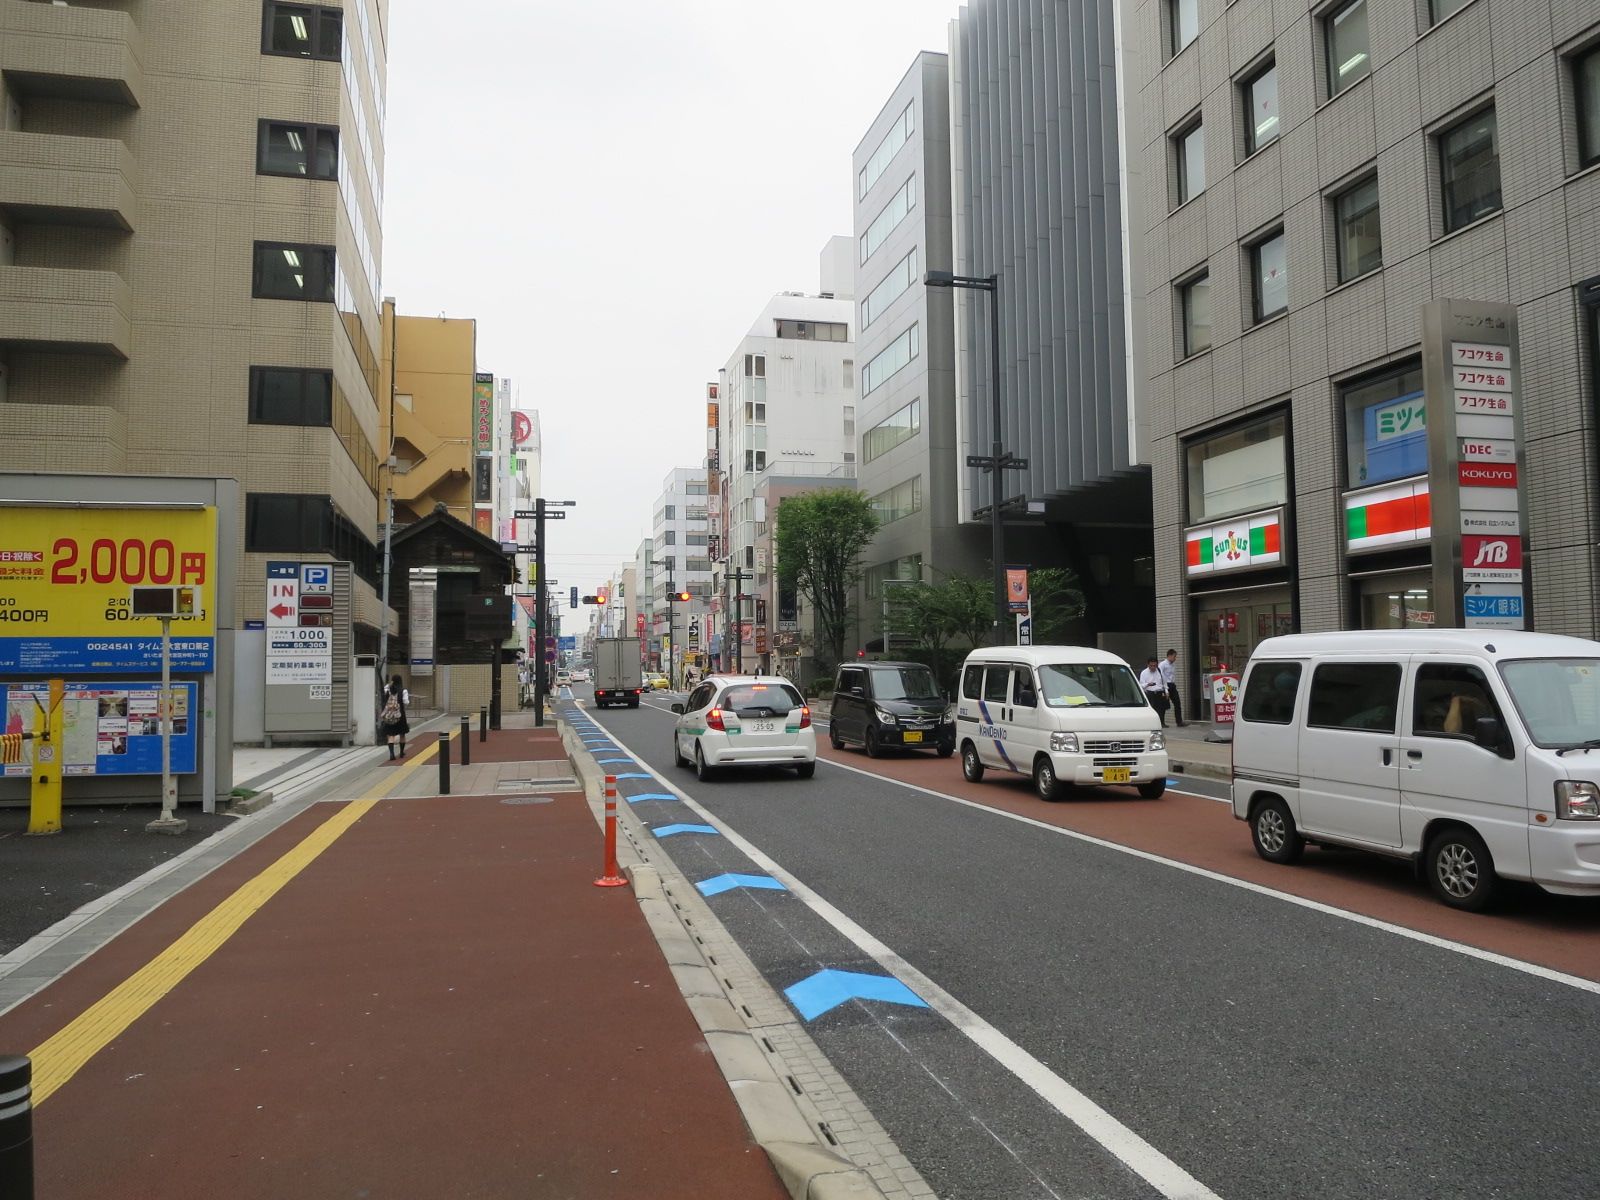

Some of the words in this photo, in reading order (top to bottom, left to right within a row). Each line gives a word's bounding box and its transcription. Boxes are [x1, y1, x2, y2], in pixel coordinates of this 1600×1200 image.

[1457, 349, 1504, 362] フコク生命
[1458, 373, 1505, 386] フコク生命
[1459, 397, 1507, 409] フコク生命
[1464, 444, 1492, 455] IDEC
[1462, 470, 1513, 480] KOKUYO
[1473, 540, 1508, 567] JTB
[51, 537, 206, 585] 2,000円
[308, 569, 325, 583] P
[273, 585, 294, 597] IN
[1467, 599, 1520, 615] ミツイ眼科
[87, 643, 133, 651] 0024541
